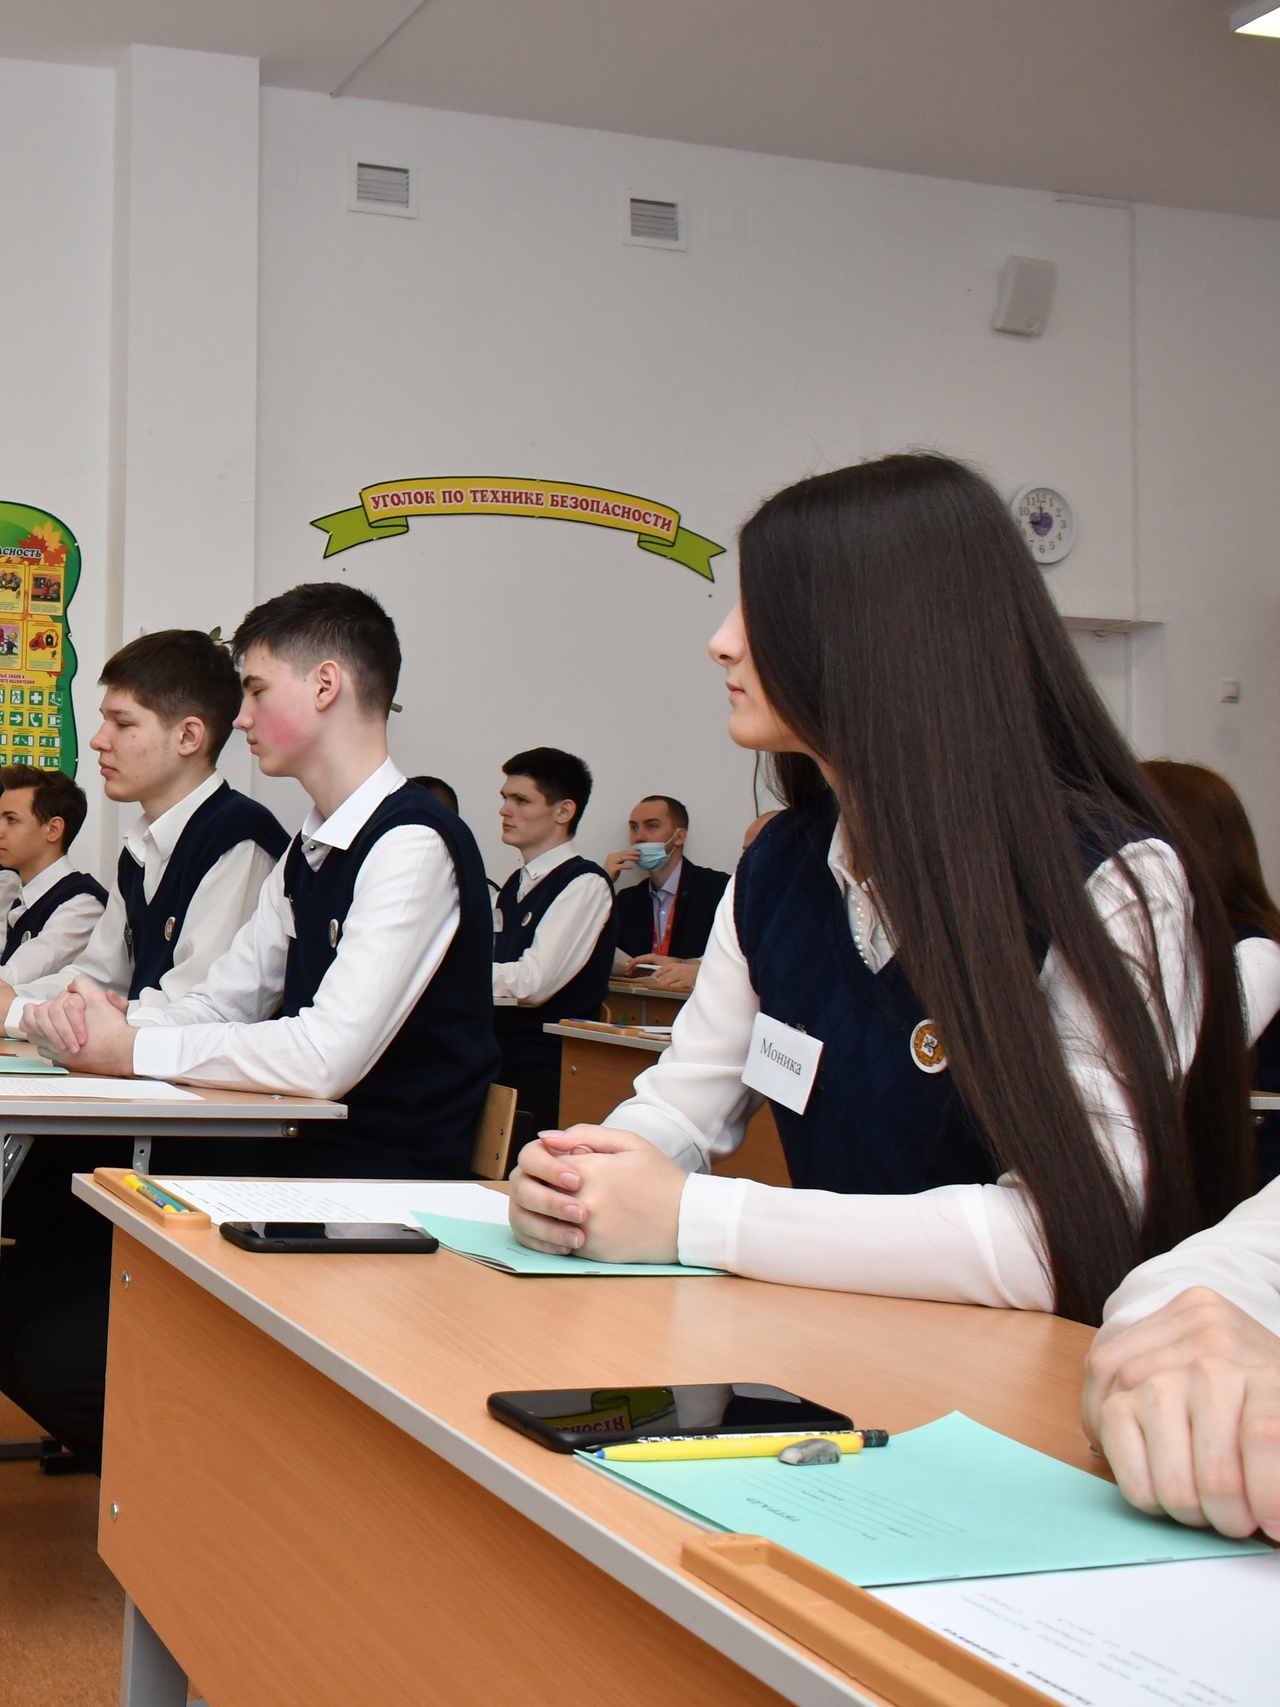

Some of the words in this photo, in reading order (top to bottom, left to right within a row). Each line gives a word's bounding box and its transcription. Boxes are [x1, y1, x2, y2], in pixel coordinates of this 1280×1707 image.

[1026, 497, 1035, 506] 11
[1036, 493, 1047, 503] 12
[1049, 498, 1053, 507] 1
[370, 490, 436, 510] УГОЛОК
[441, 489, 465, 504] ПО
[469, 489, 545, 506] ТЕХНИКЕ
[550, 493, 673, 532] БЕЗОПАСНОСТИ
[1019, 506, 1029, 516] 10
[1056, 507, 1061, 517] 2
[1060, 520, 1066, 529] 3
[1039, 545, 1045, 553] 6
[1049, 541, 1055, 550] 5
[760, 1038, 802, 1076] Моника
